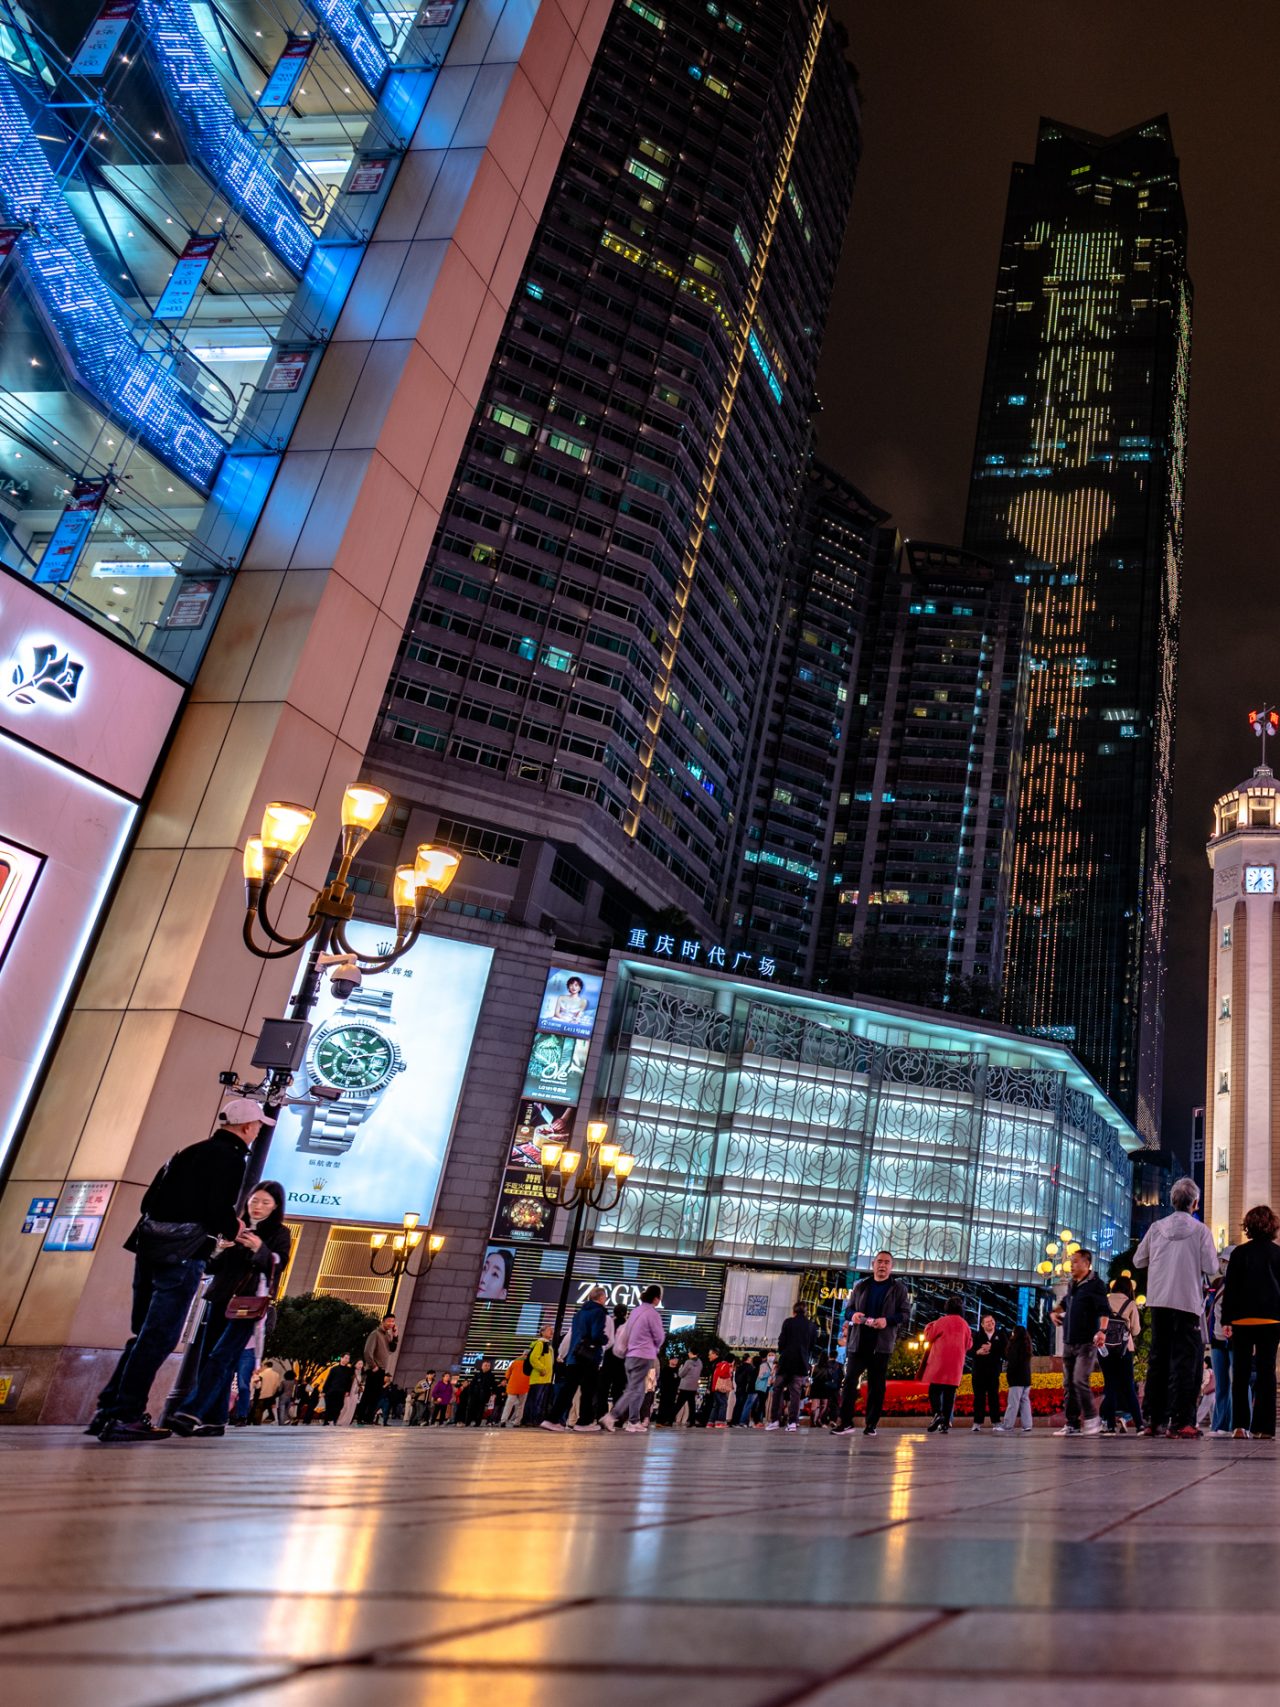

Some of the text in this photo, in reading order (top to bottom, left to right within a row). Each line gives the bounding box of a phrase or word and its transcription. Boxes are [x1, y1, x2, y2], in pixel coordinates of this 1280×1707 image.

[628, 928, 776, 977] 重庆时代广场
[288, 1192, 342, 1206] ROLEX
[820, 1287, 854, 1300] SAIN
